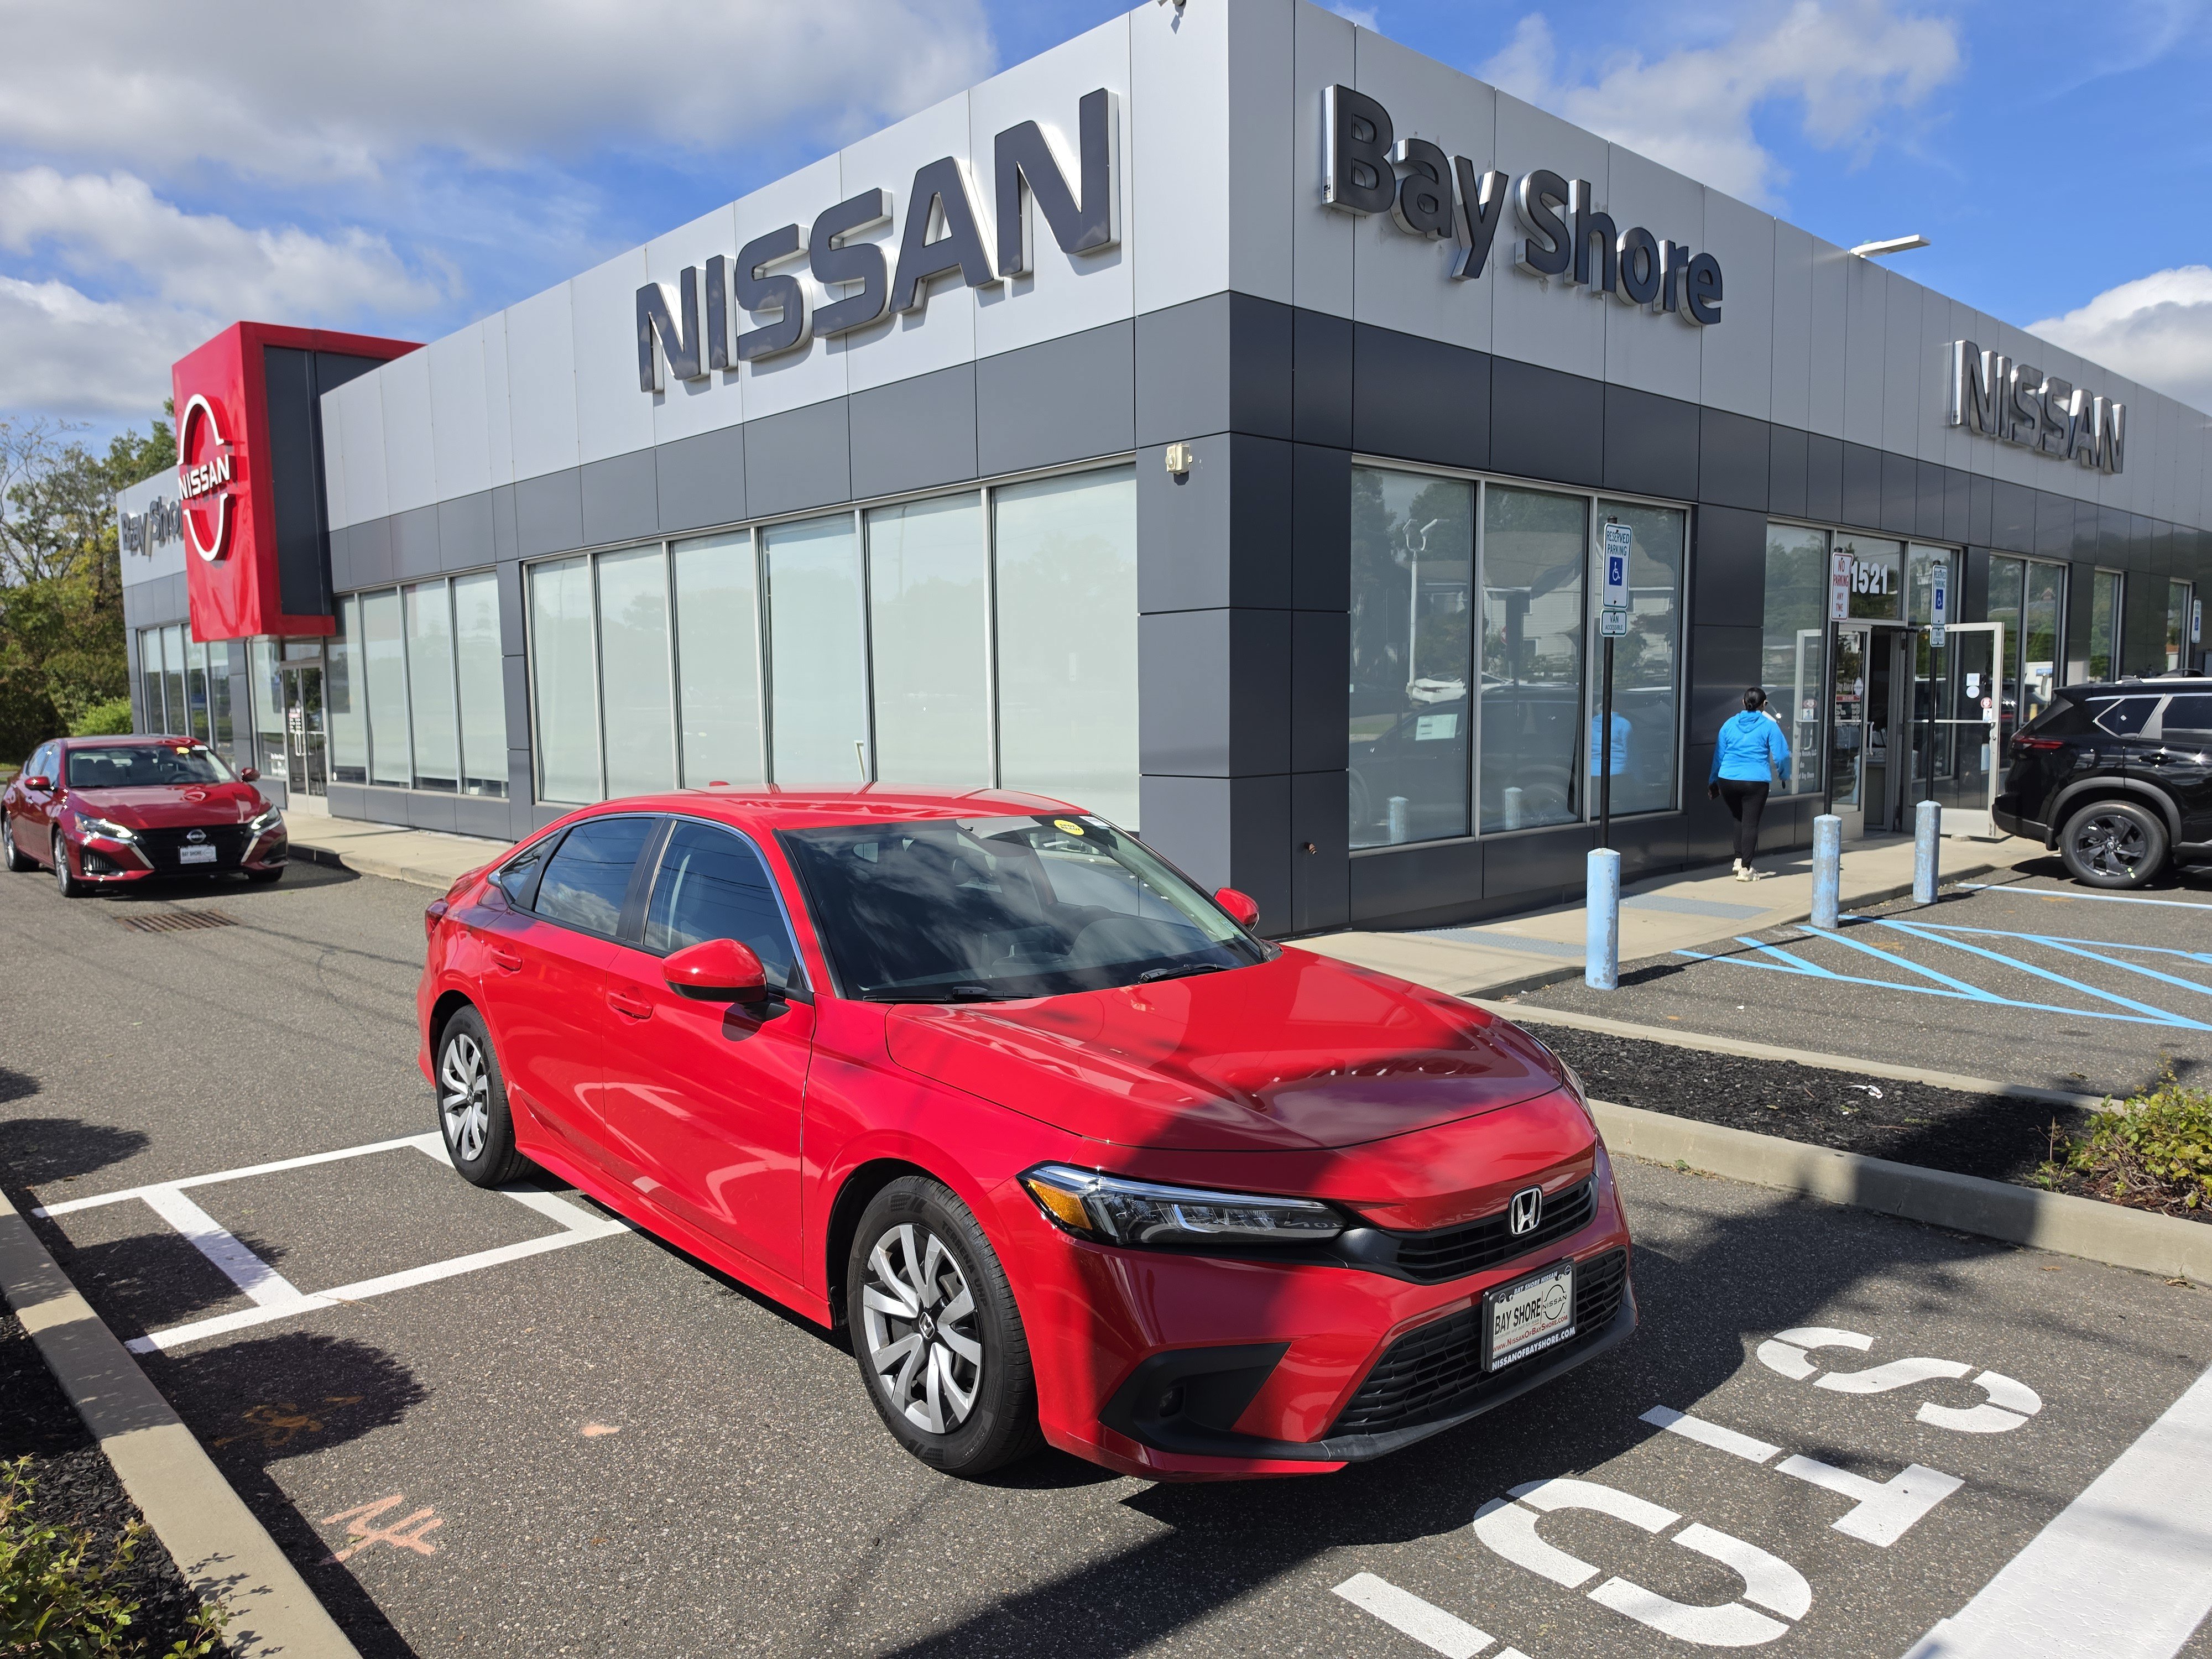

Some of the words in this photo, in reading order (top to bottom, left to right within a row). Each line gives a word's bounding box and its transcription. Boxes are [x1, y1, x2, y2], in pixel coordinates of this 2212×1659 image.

[1322, 84, 1509, 281] Bay
[1515, 169, 1723, 327] Shore
[637, 87, 1121, 394] NISSAN
[1952, 340, 2126, 474] NISSAN
[178, 454, 231, 500] NISSAN
[121, 512, 152, 556] Bay
[1606, 530, 1630, 544] RESERVED
[1607, 544, 1627, 556] PARKING
[1833, 575, 1849, 587] PARKING
[1838, 560, 1845, 573] NO
[1851, 560, 1888, 594] 1521
[1610, 615, 1619, 623] VAN
[941, 1220, 976, 1275] TERRENA
[974, 1277, 988, 1308] UHP
[1514, 1285, 1524, 1295] BAY
[1525, 1279, 1540, 1290] SHORE
[1541, 1271, 1558, 1284] NISSAN
[1494, 1310, 1512, 1335] BAY
[1513, 1297, 1541, 1327] SHORE
[1542, 1295, 1567, 1310] NISSAN
[1492, 1326, 1575, 1371] NISSANOFBAYSHORE.COM
